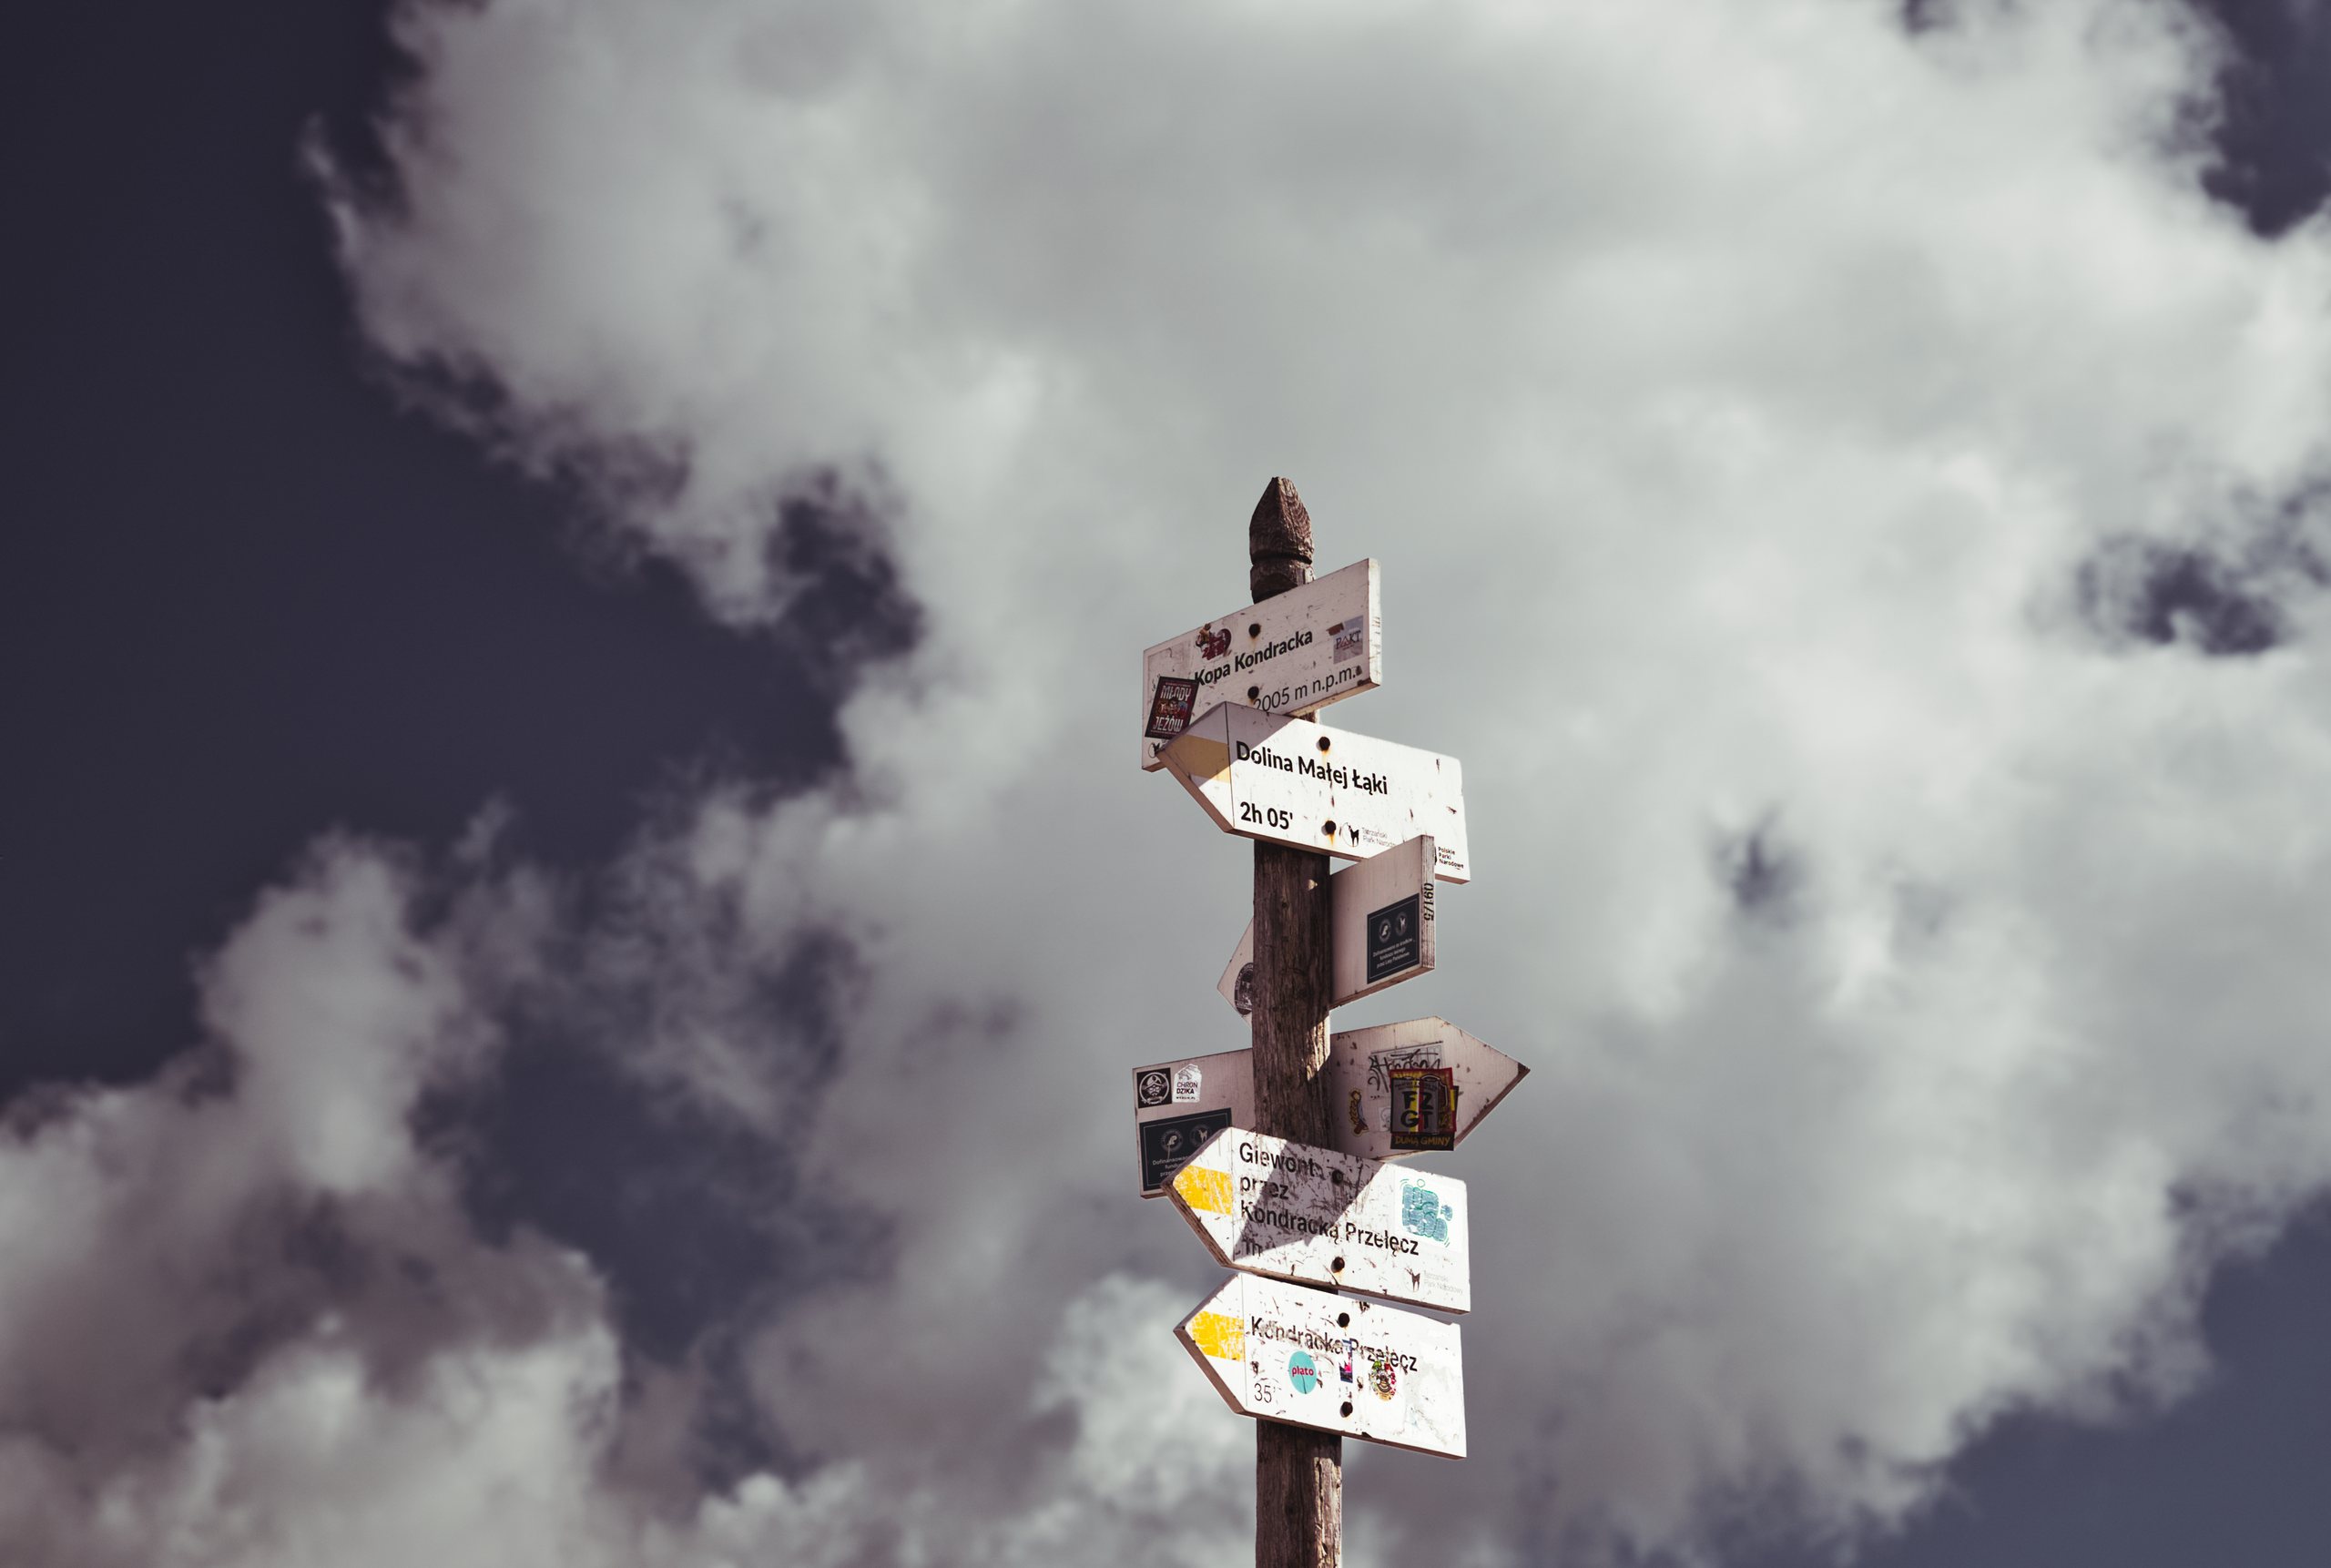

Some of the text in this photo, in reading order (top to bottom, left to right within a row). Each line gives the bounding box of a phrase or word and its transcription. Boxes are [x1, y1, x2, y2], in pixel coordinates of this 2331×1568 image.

[1195, 630, 1313, 686] Kopa Kondracka
[1295, 685, 1308, 700] m
[1312, 667, 1356, 692] n.p.m.
[1237, 740, 1388, 795] Dolina Małej Łąki
[1240, 801, 1293, 830] 2h 05'
[1420, 1136, 1451, 1145] GMINY
[1241, 1199, 1339, 1245] Kondracką
[1346, 1222, 1420, 1257] Przełęcz
[1291, 1366, 1314, 1377] plato
